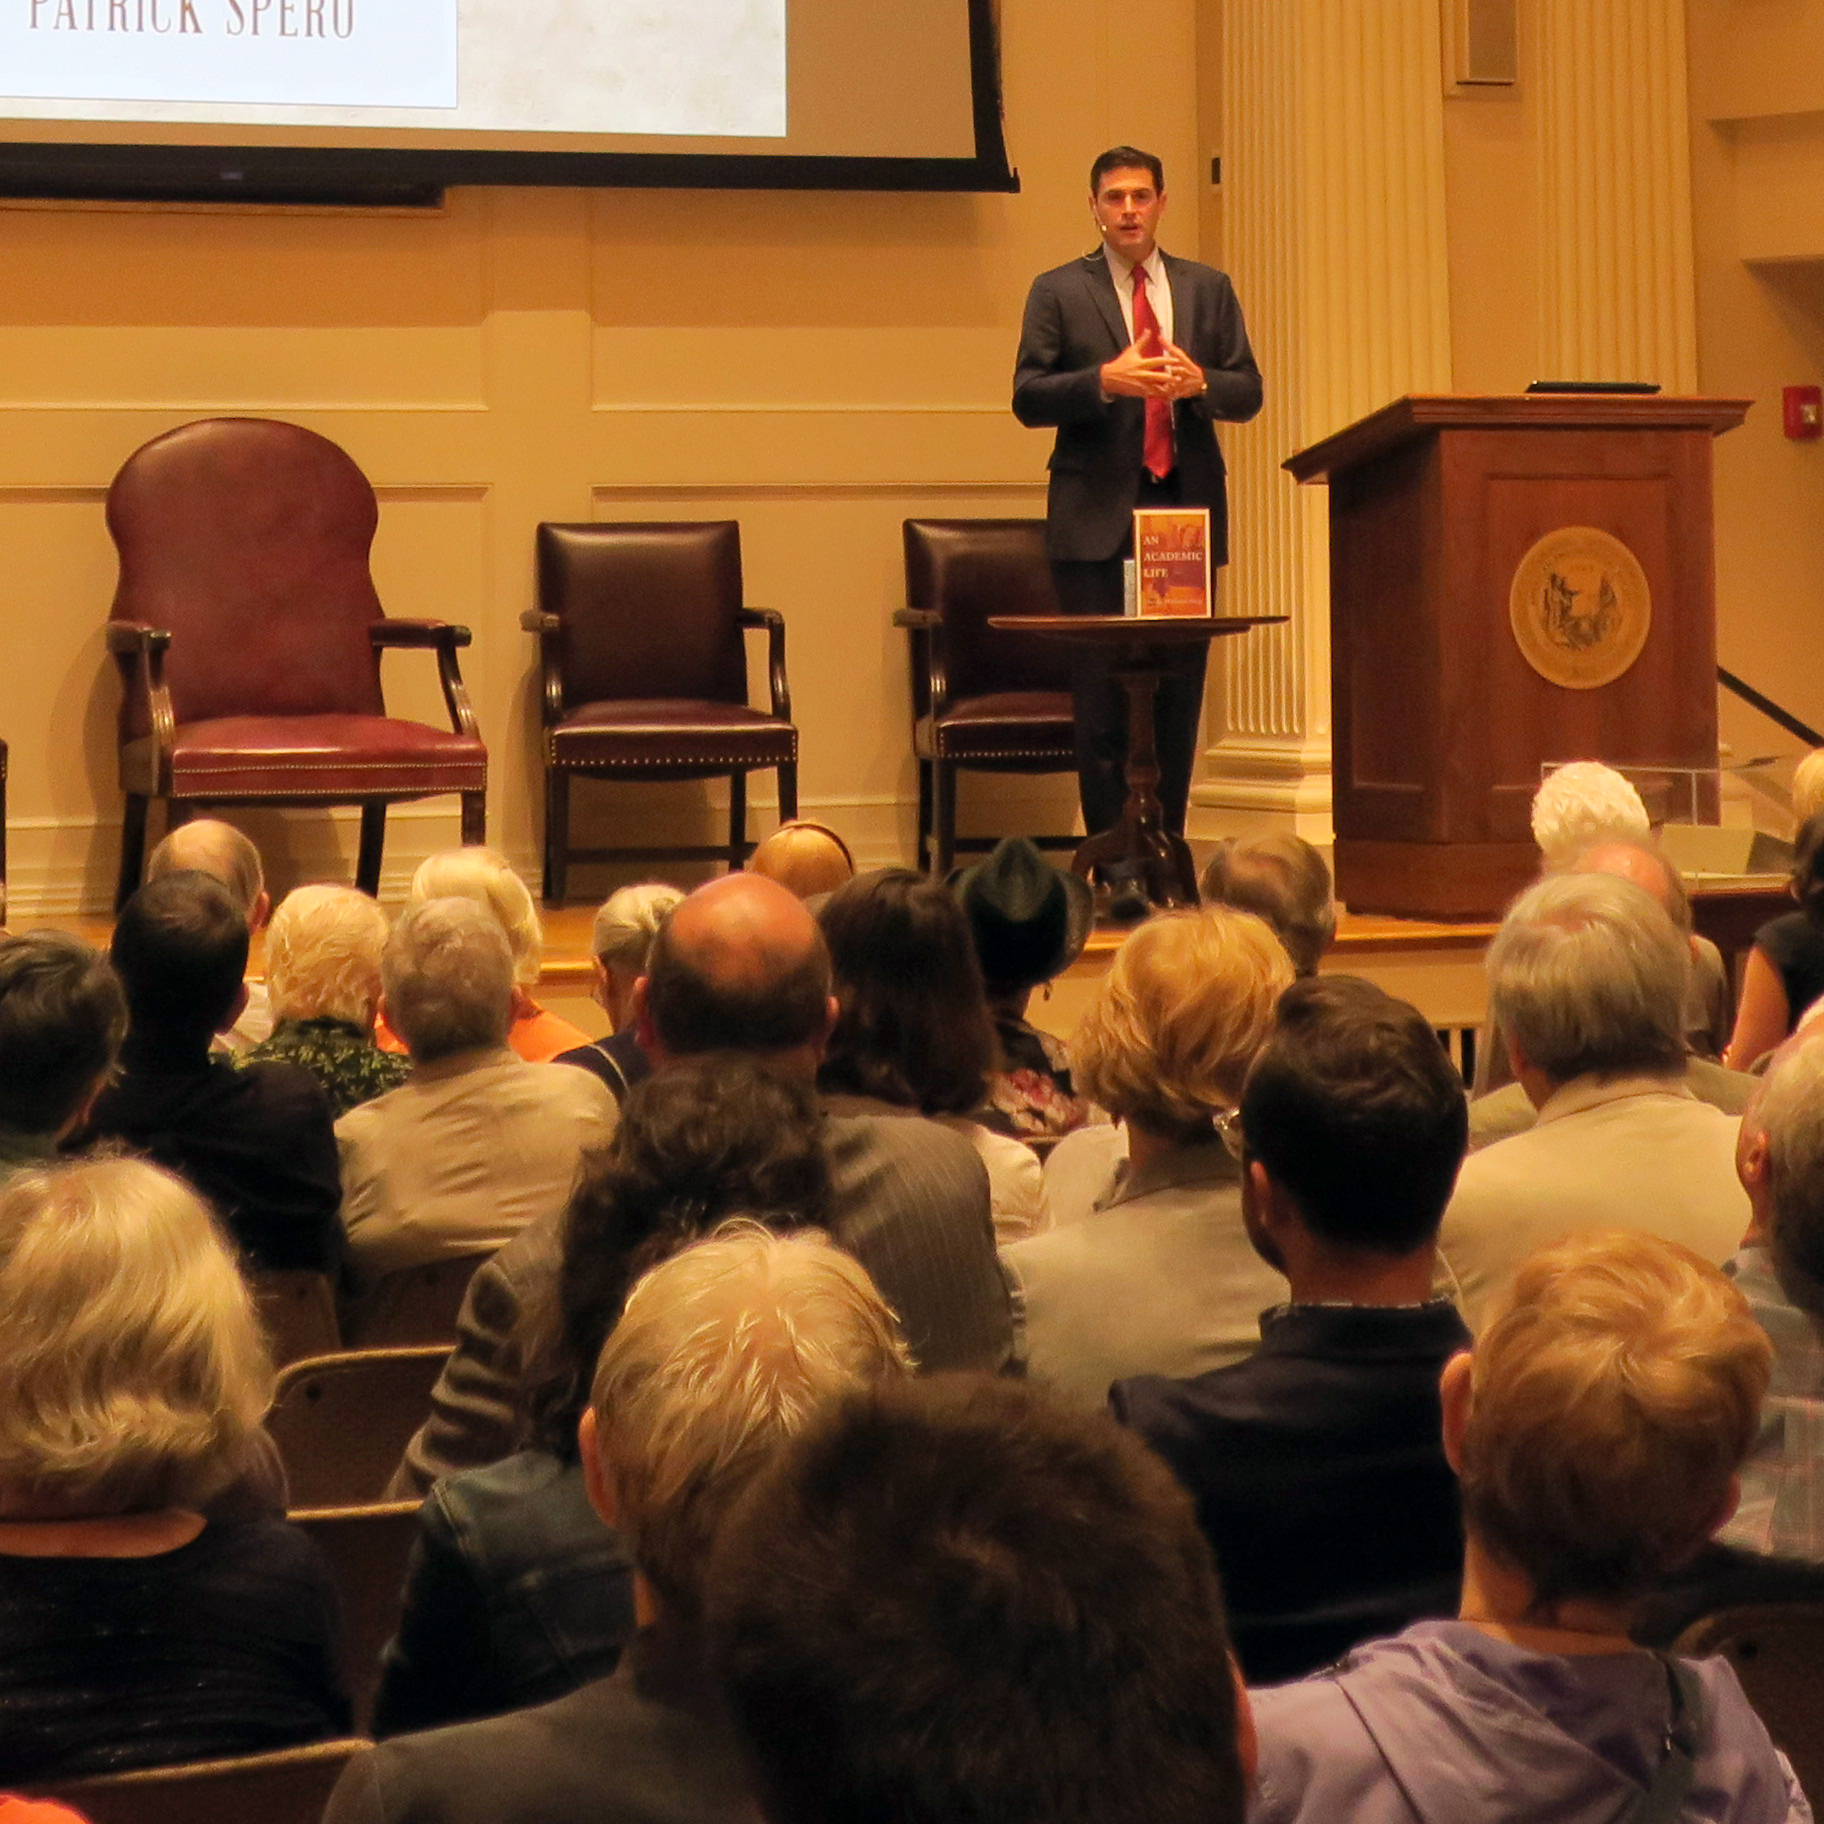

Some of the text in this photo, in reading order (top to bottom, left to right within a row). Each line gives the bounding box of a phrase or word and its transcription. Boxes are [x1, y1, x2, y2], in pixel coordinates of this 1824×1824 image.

[1143, 535, 1160, 545] AN
[1143, 551, 1203, 562] ACADEMIC
[1143, 568, 1169, 579] LIFE
